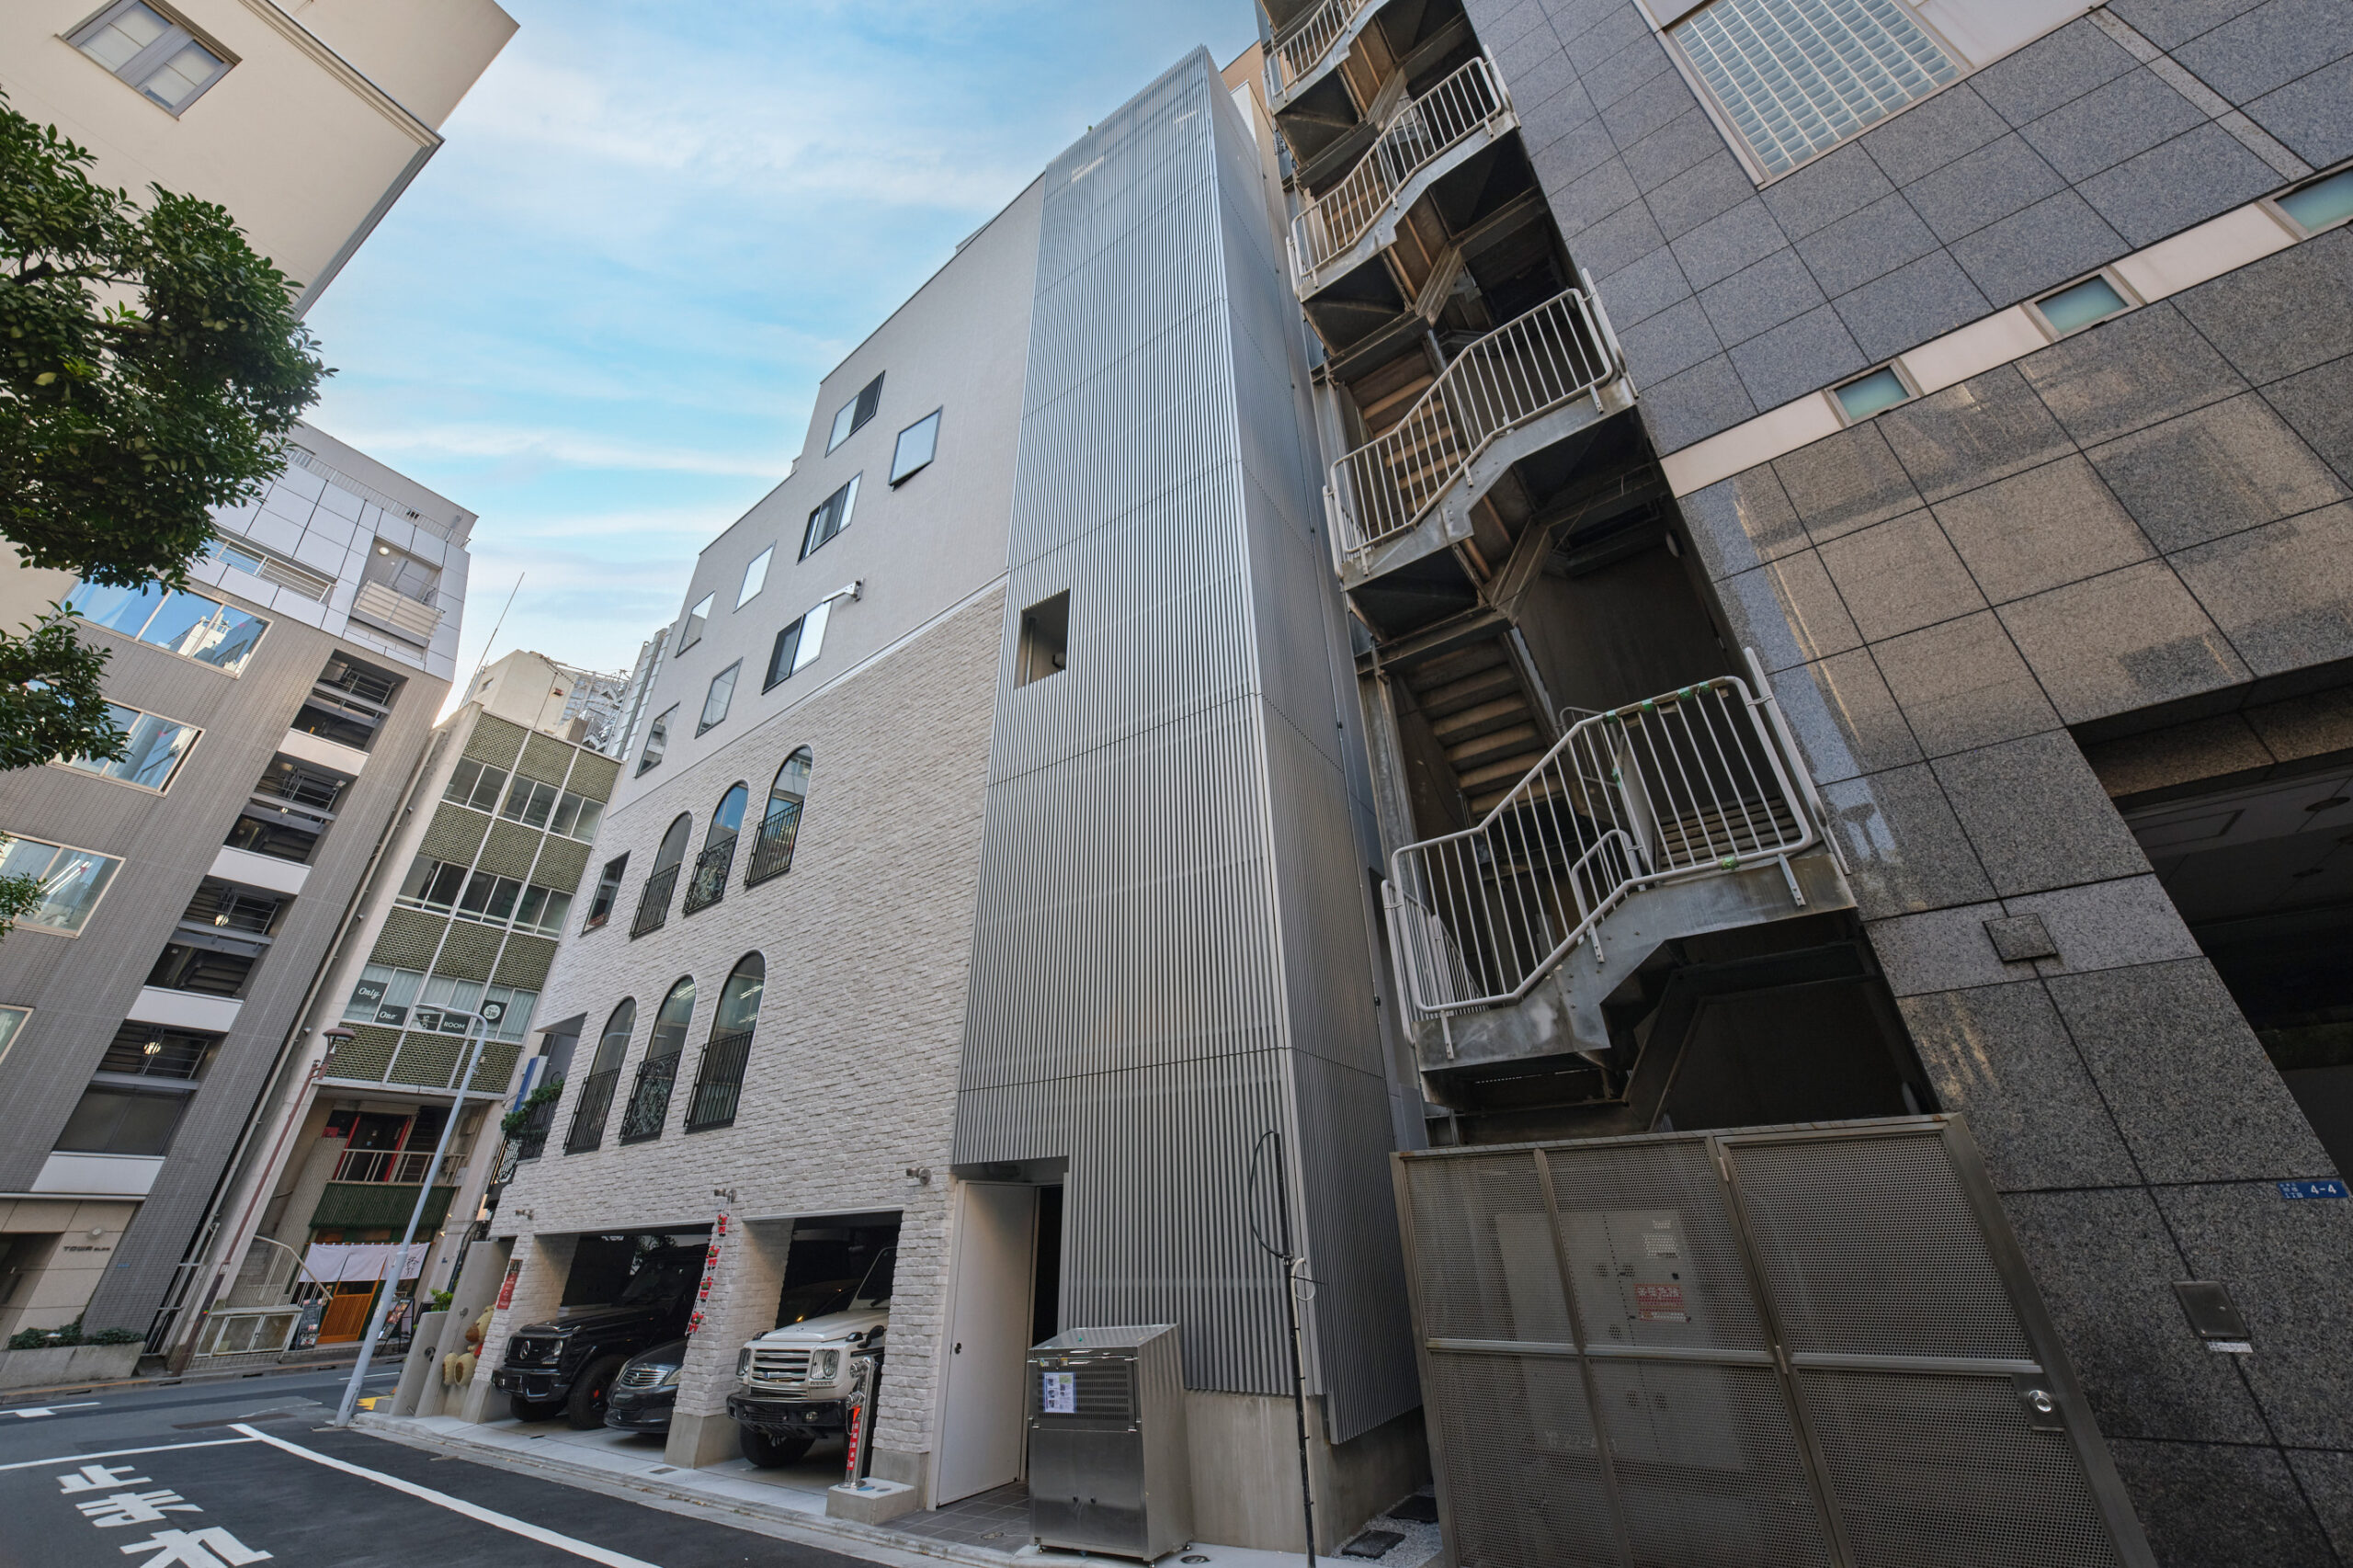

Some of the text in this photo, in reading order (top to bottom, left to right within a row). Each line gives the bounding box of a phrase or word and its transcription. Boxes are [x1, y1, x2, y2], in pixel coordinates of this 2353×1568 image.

[358, 987, 381, 999] Only
[379, 1011, 396, 1019] One
[443, 1021, 465, 1029] ROOM
[2311, 1185, 2336, 1194] 4-4
